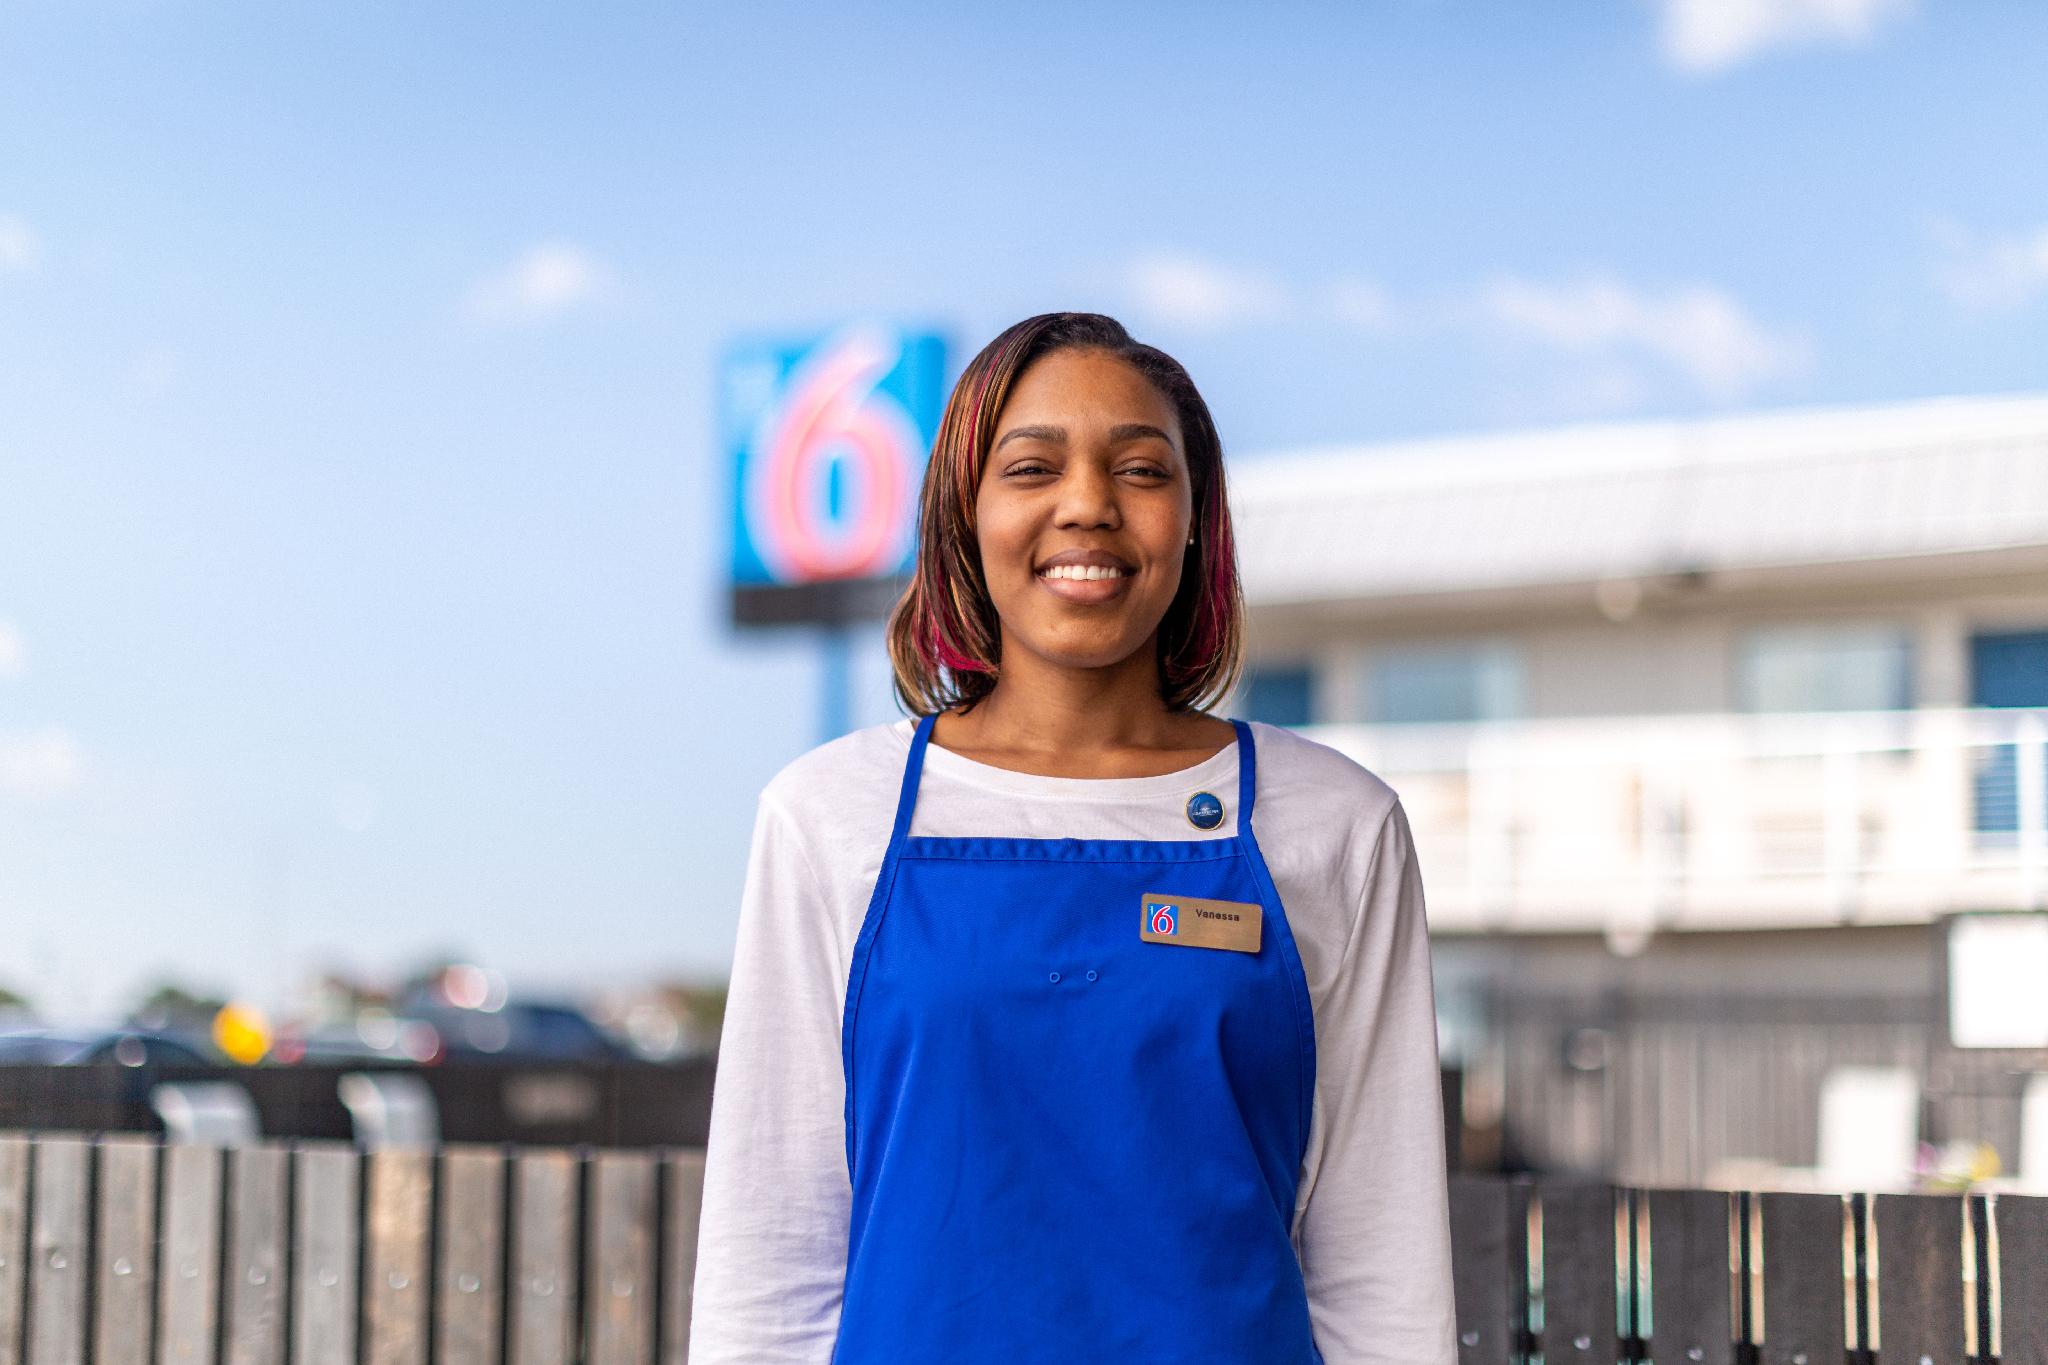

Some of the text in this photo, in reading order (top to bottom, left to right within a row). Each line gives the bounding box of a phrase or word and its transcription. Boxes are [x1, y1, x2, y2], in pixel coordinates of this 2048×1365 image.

[749, 324, 914, 581] 6
[1152, 905, 1174, 935] 6
[1196, 908, 1240, 922] Vanessa
